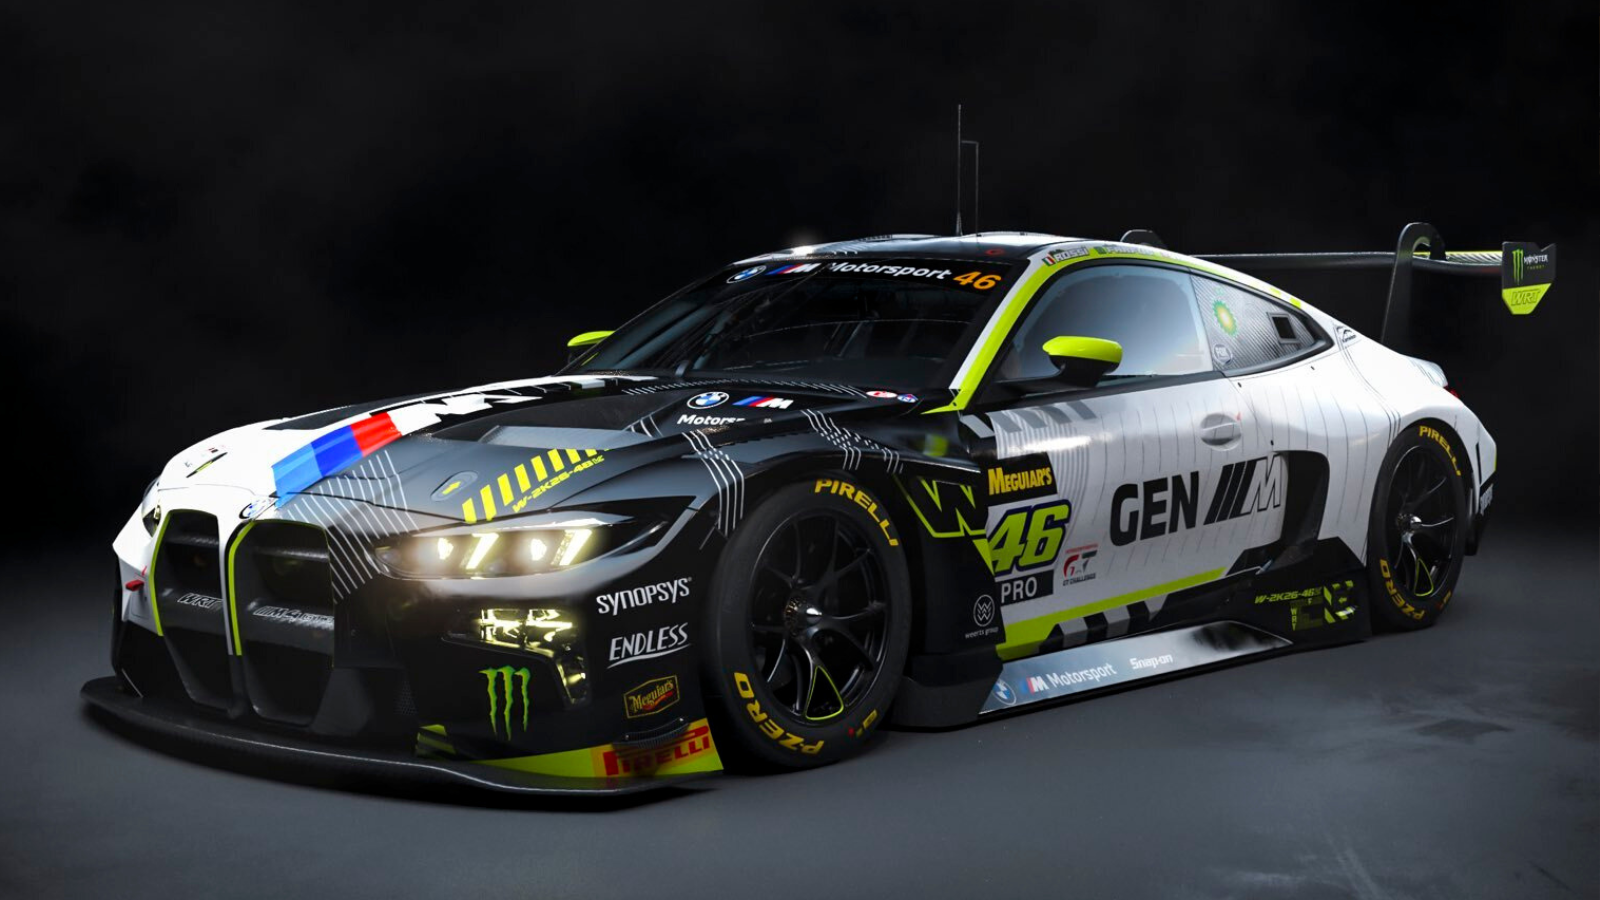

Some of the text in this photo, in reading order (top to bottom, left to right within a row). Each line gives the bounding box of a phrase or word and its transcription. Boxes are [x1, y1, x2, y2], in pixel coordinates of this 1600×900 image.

[952, 270, 1002, 291] 46
[1418, 425, 1462, 477] PIRELLI
[814, 478, 899, 547] PIRELLI
[1109, 470, 1200, 546] GEN
[988, 499, 1071, 576] 46
[1001, 577, 1038, 604] PRO
[608, 622, 690, 662] ENDLESS
[1049, 663, 1117, 688] Motorsport
[602, 722, 711, 777] PIRELLI
